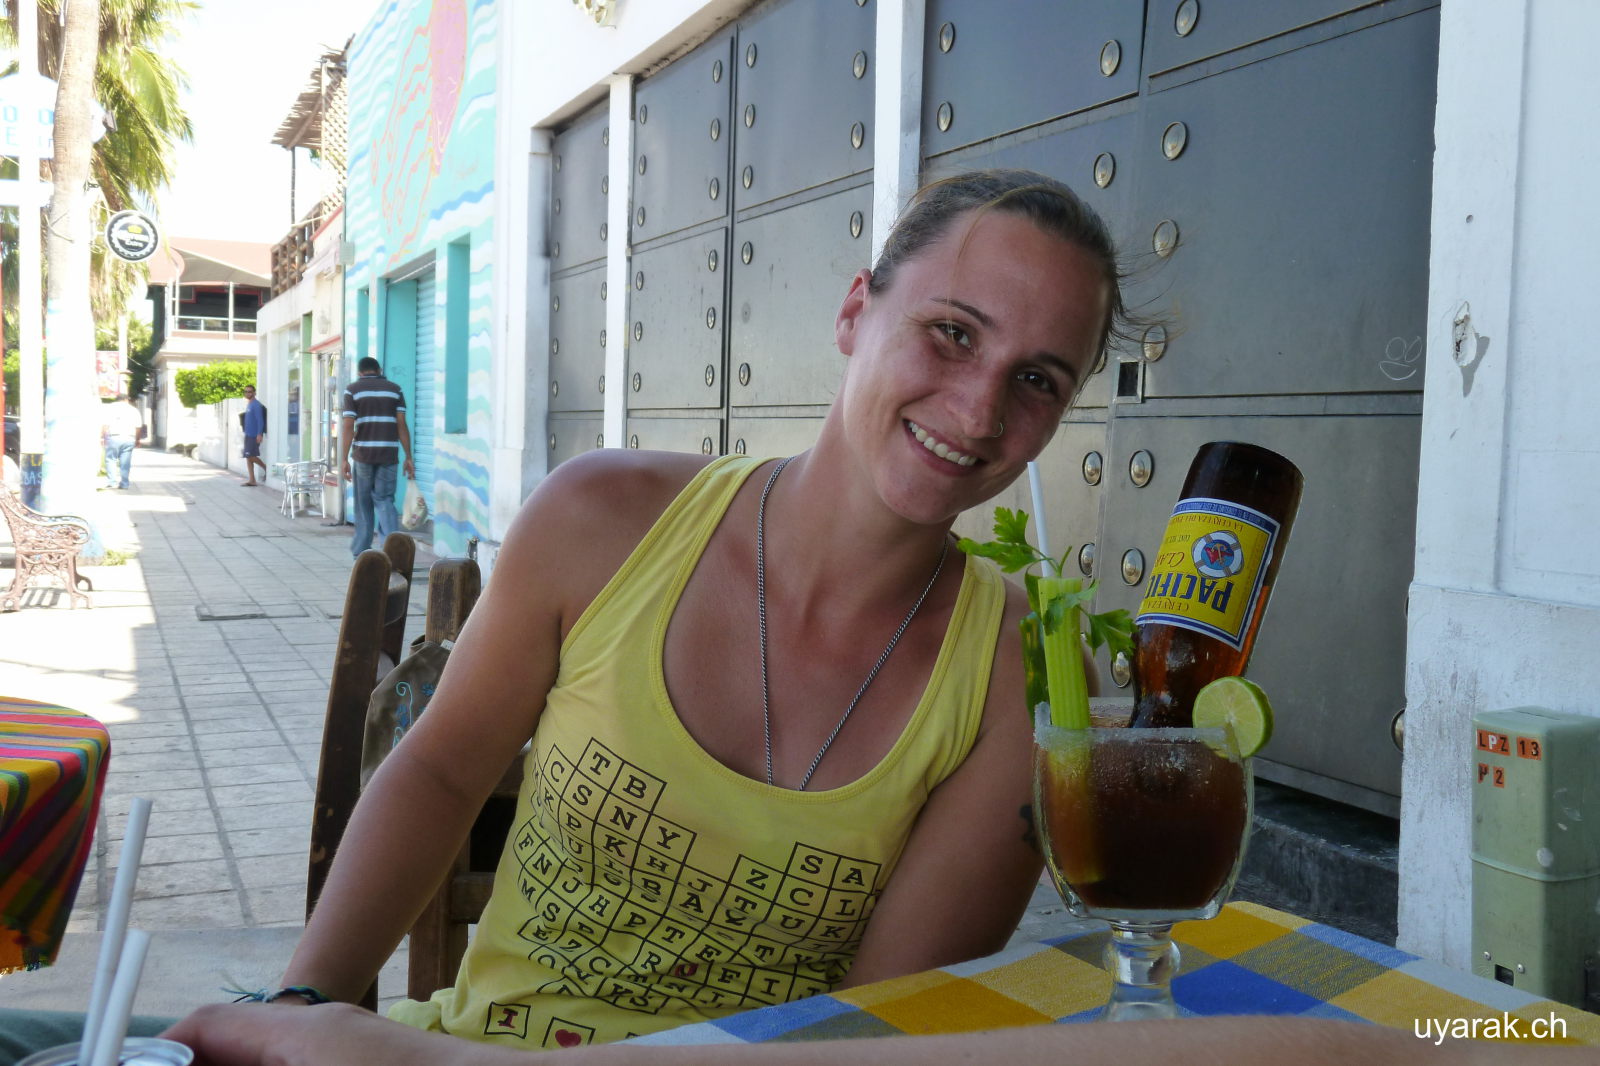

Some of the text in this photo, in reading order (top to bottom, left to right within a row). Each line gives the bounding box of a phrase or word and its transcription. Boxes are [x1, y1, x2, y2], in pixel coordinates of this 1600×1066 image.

[1519, 740, 1539, 756] 13
[1495, 769, 1504, 785] 2
[589, 751, 865, 887] T B S A
[550, 761, 855, 916] C S N Y Z C L
[532, 852, 552, 875] N
[588, 894, 611, 917] H
[661, 925, 686, 944] T
[603, 834, 627, 858] K
[645, 855, 670, 874] H
[687, 877, 713, 893] J
[734, 895, 758, 914] T
[780, 914, 806, 930] U
[820, 925, 847, 939] K
[679, 891, 704, 914] A
[542, 902, 561, 923] S
[640, 951, 662, 973] R
[717, 967, 741, 984] F
[760, 977, 780, 997] I
[753, 944, 776, 963] T
[588, 956, 612, 976] C
[497, 1007, 519, 1029] I
